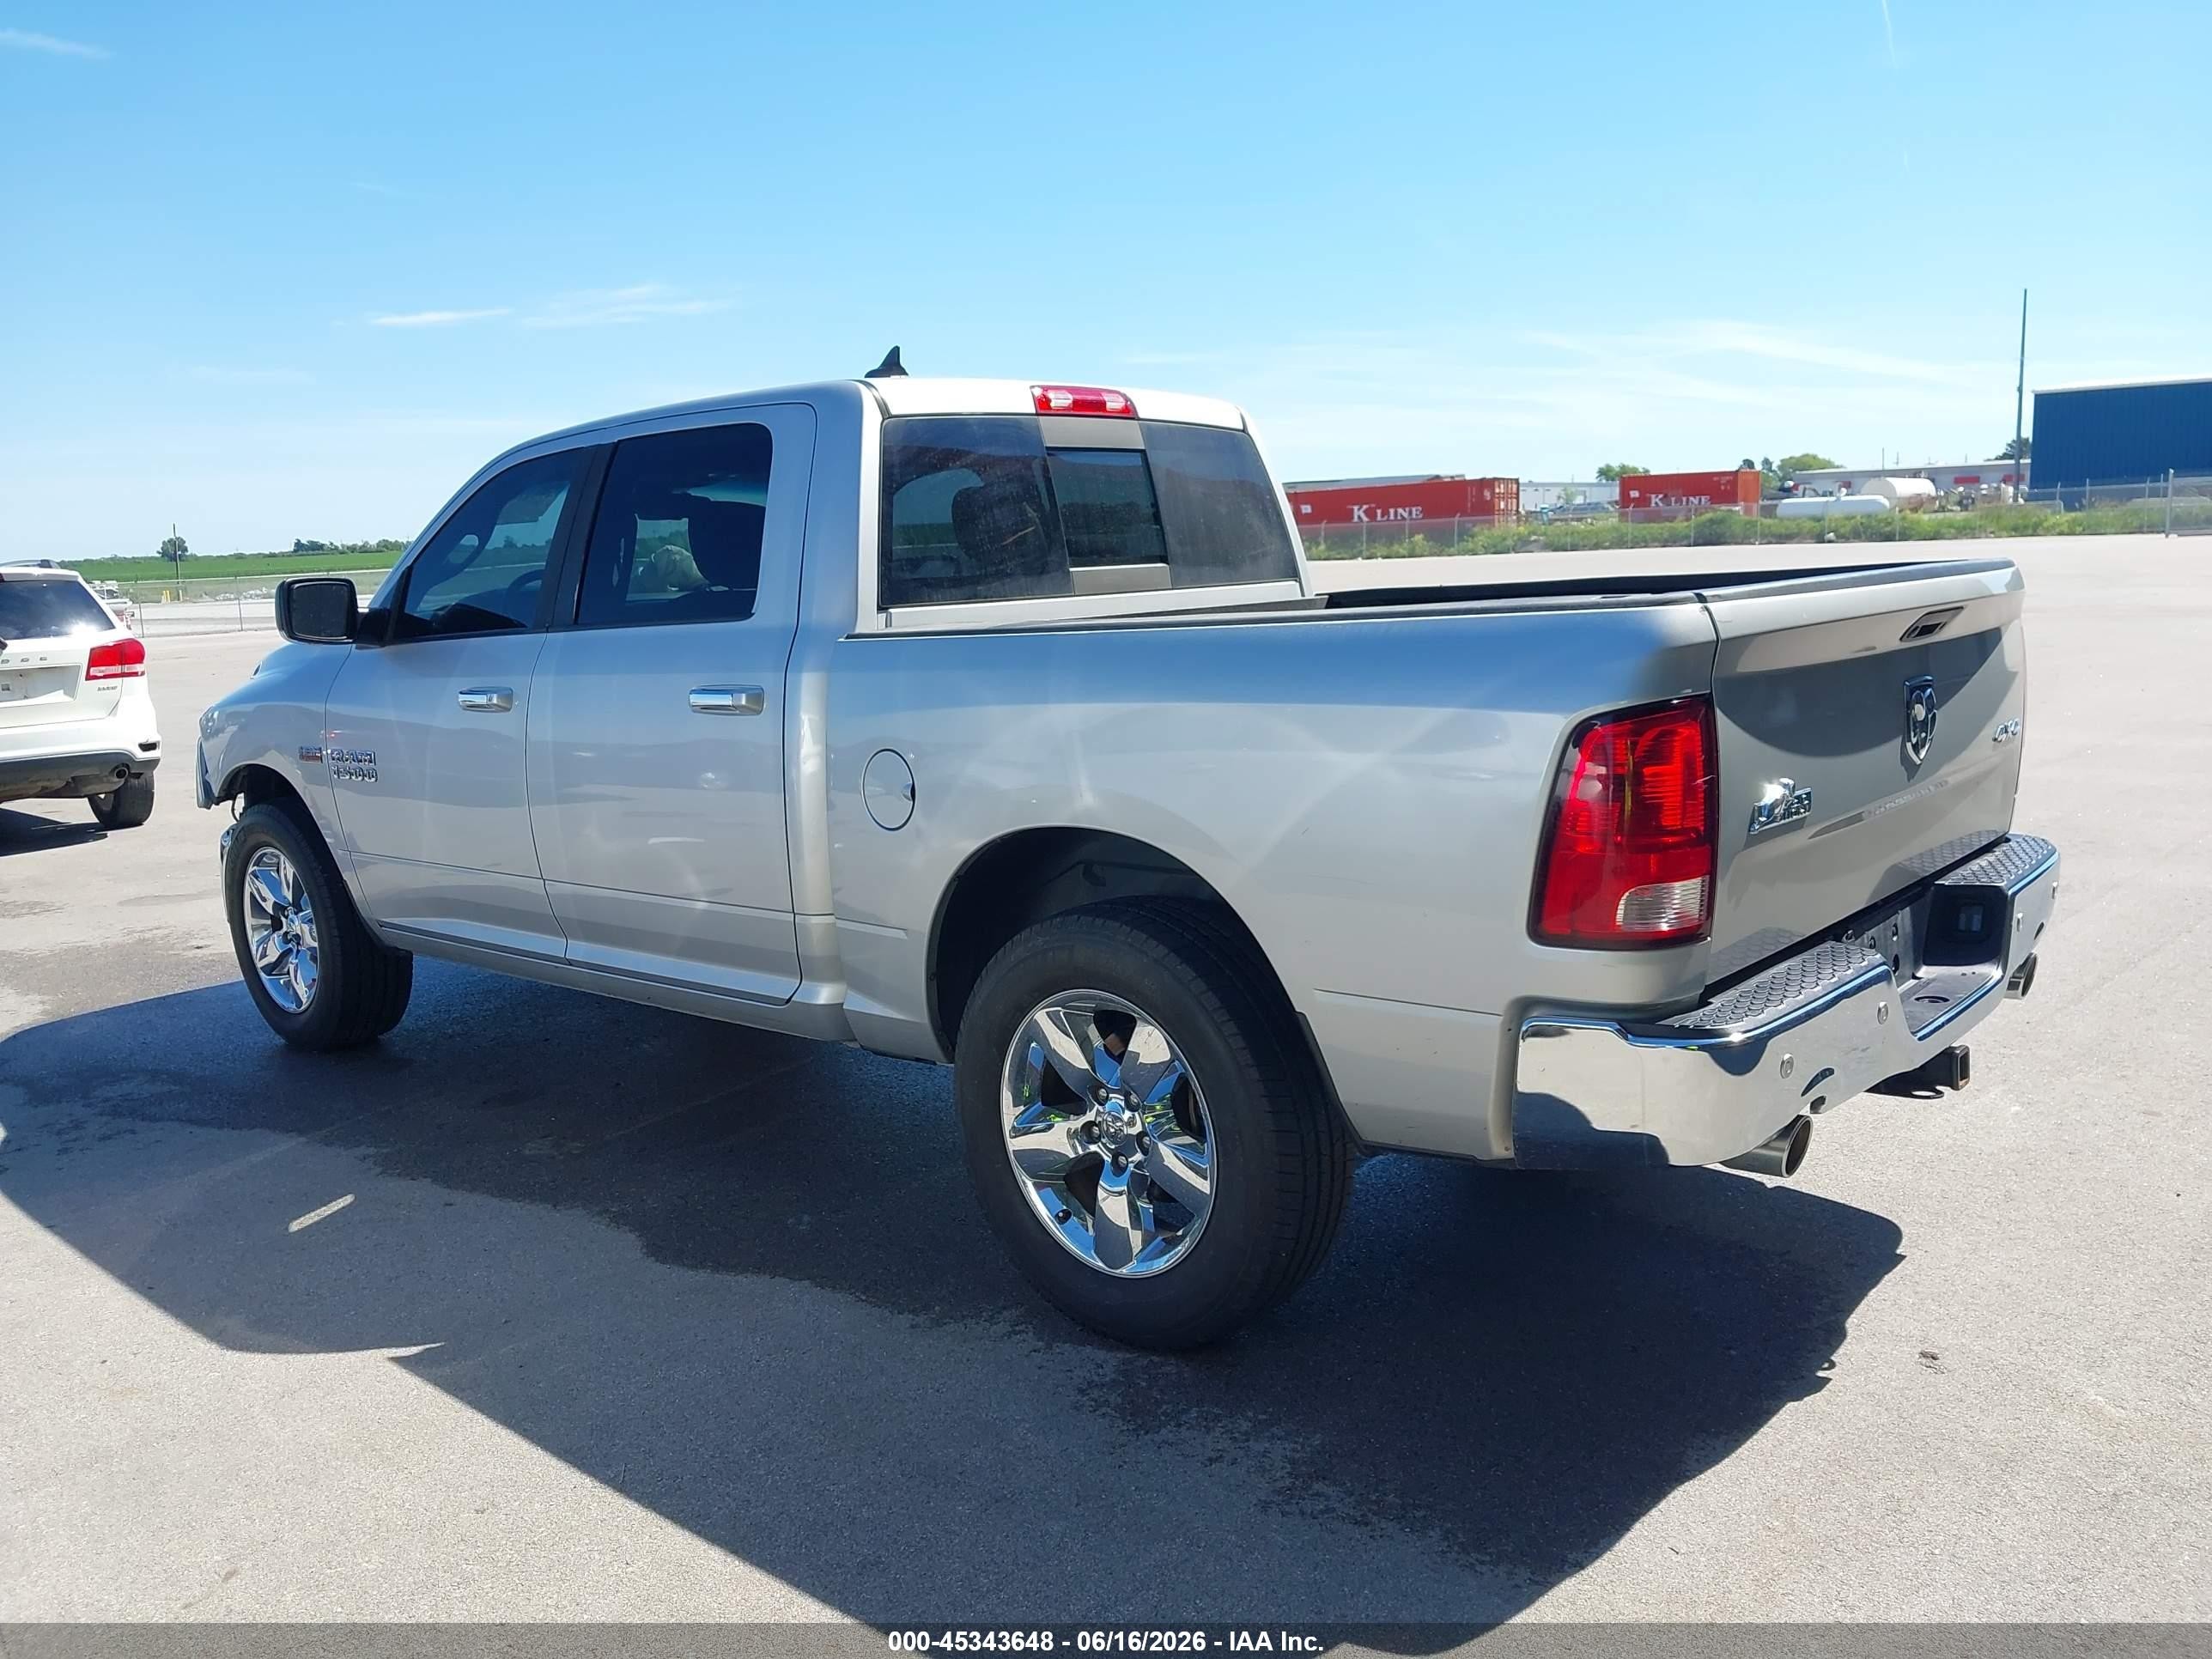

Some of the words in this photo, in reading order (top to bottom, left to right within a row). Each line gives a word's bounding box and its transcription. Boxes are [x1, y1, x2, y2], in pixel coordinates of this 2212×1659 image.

[1650, 494, 1664, 507] K
[1670, 495, 1711, 507] LINE
[1352, 504, 1370, 522] K
[1376, 507, 1422, 521] LINE
[331, 764, 378, 783] 1500
